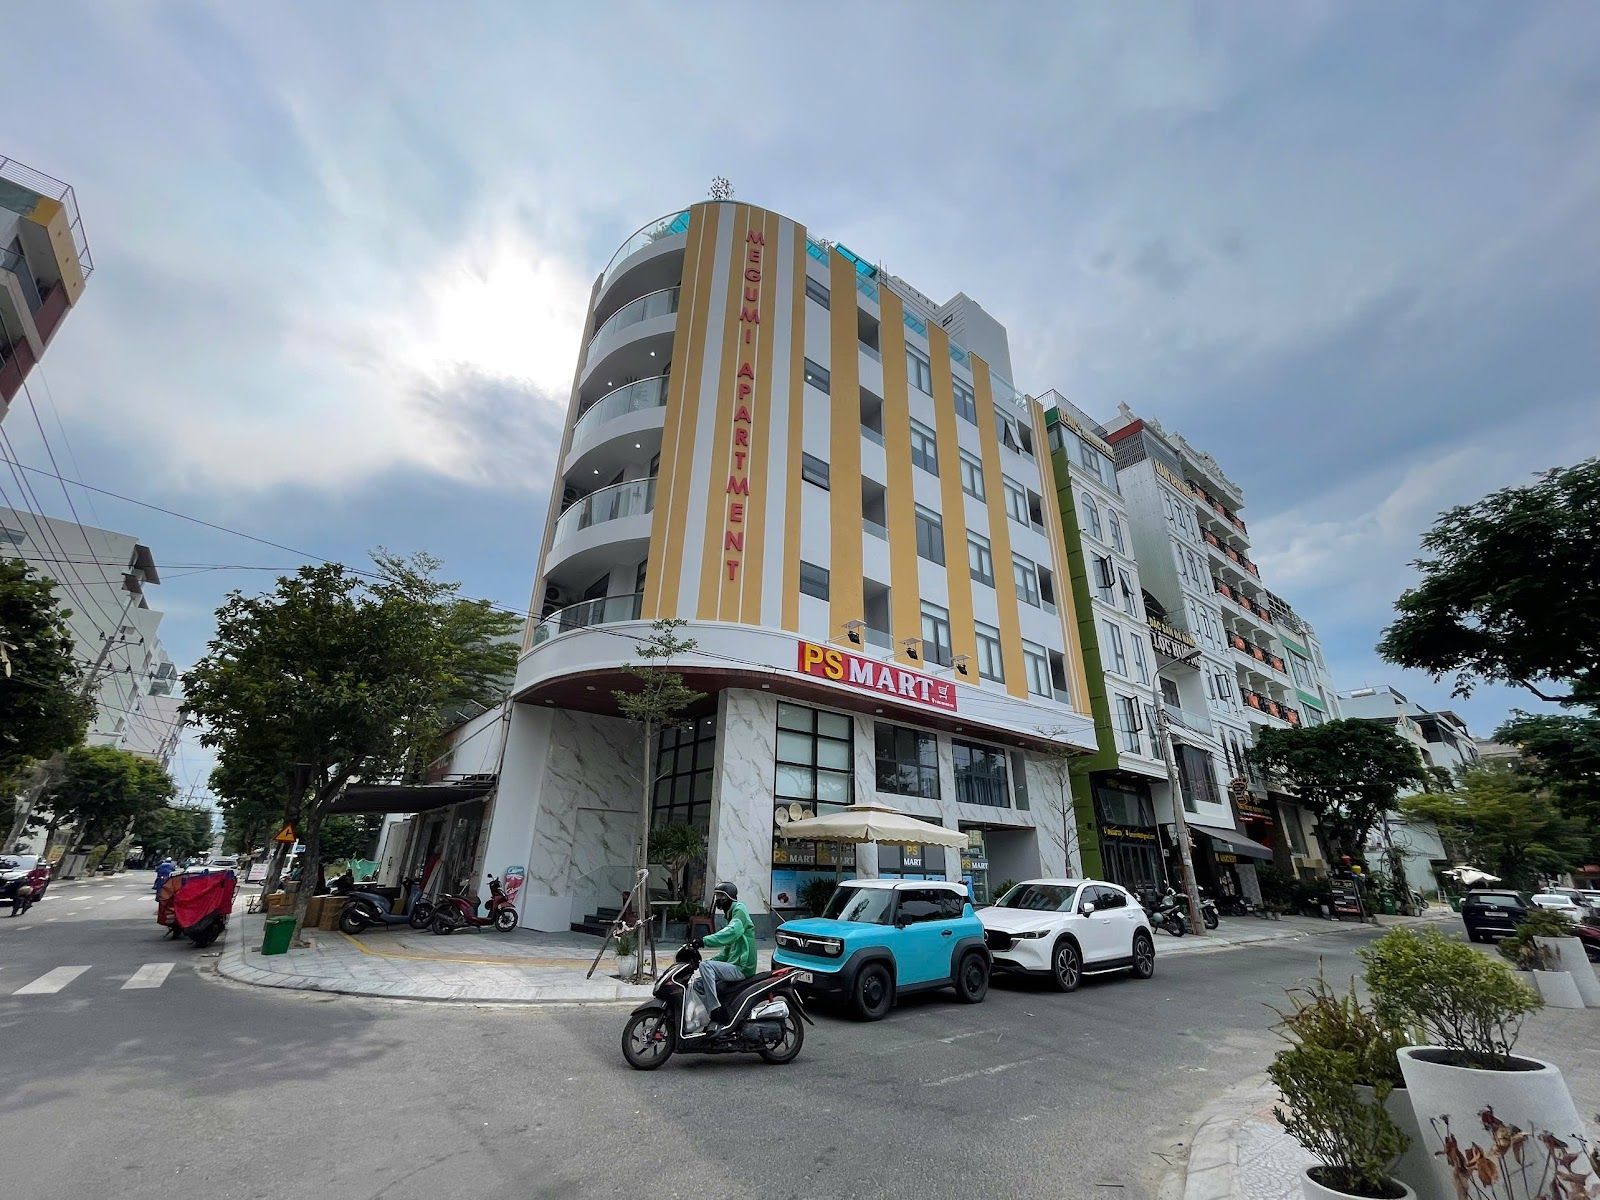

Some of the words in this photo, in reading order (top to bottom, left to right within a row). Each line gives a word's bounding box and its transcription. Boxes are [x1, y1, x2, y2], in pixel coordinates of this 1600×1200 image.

[740, 229, 765, 344] MEGUMI
[725, 362, 754, 582] APARTMENT
[804, 643, 844, 680] PS
[849, 657, 933, 702] MART
[773, 849, 787, 864] PS
[789, 854, 815, 863] MART
[906, 845, 918, 856] PS
[904, 857, 922, 866] MART
[961, 857, 972, 869] PS
